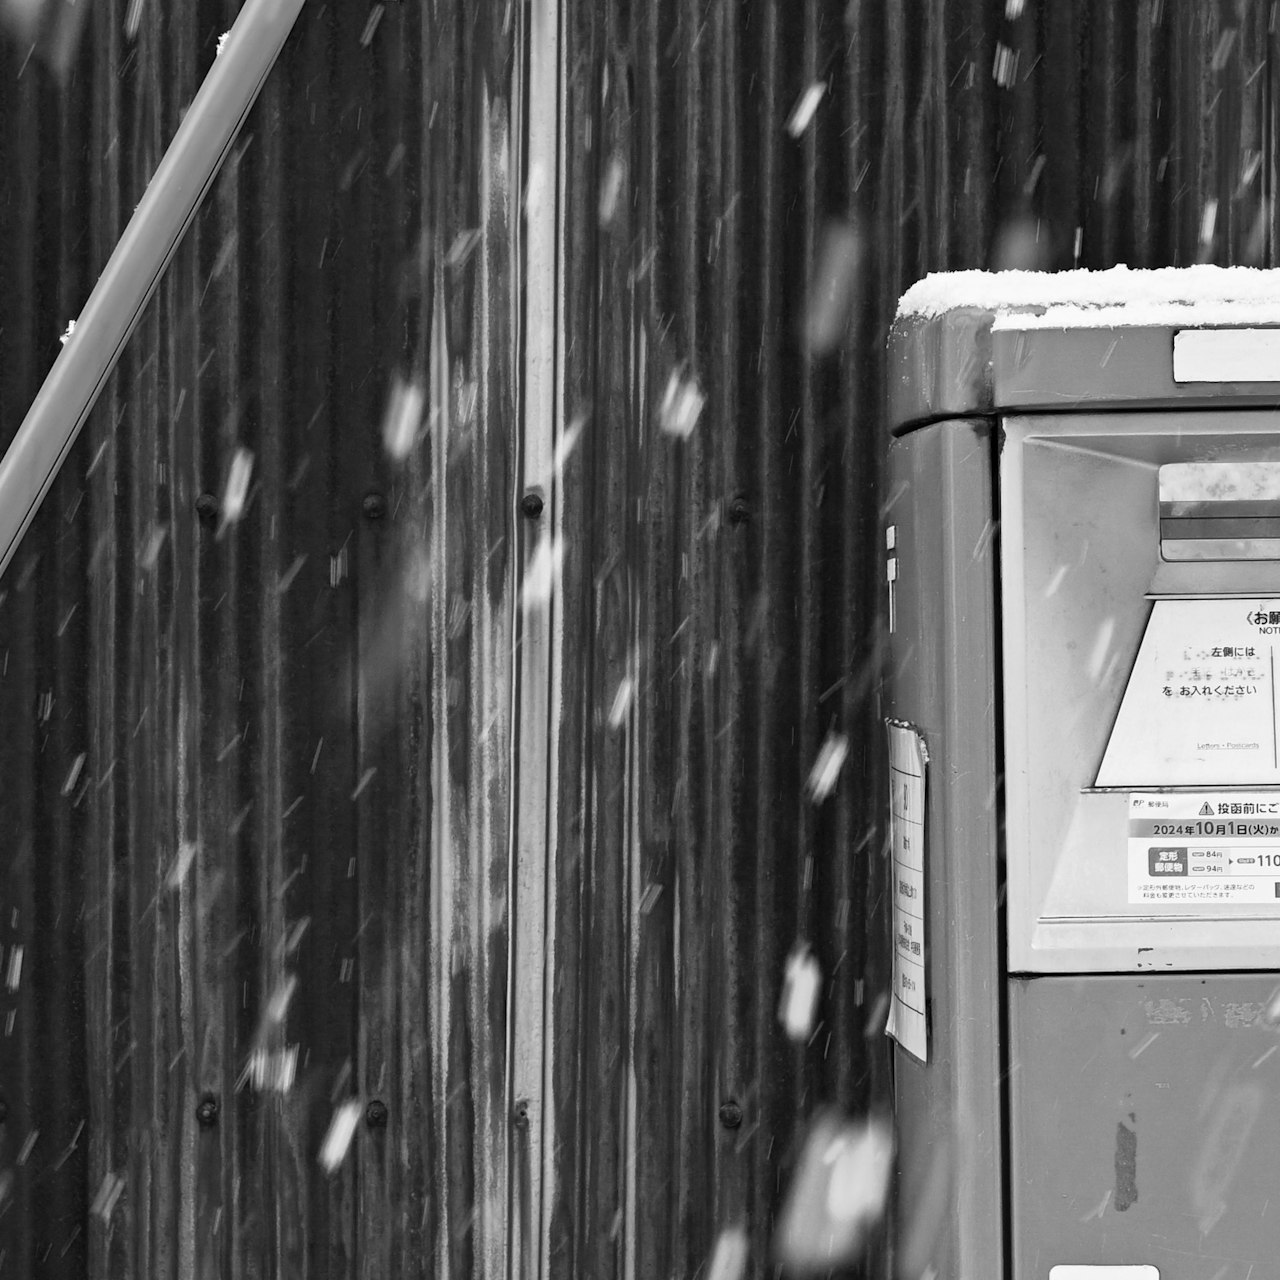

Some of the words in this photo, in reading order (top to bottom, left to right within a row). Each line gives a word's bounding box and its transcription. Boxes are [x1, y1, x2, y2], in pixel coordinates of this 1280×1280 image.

[1210, 645, 1256, 658] 左側には
[1179, 684, 1258, 697] お入れください
[1206, 849, 1223, 858] 84円
[1154, 861, 1183, 872] 郵便物
[1206, 865, 1223, 874] 94円
